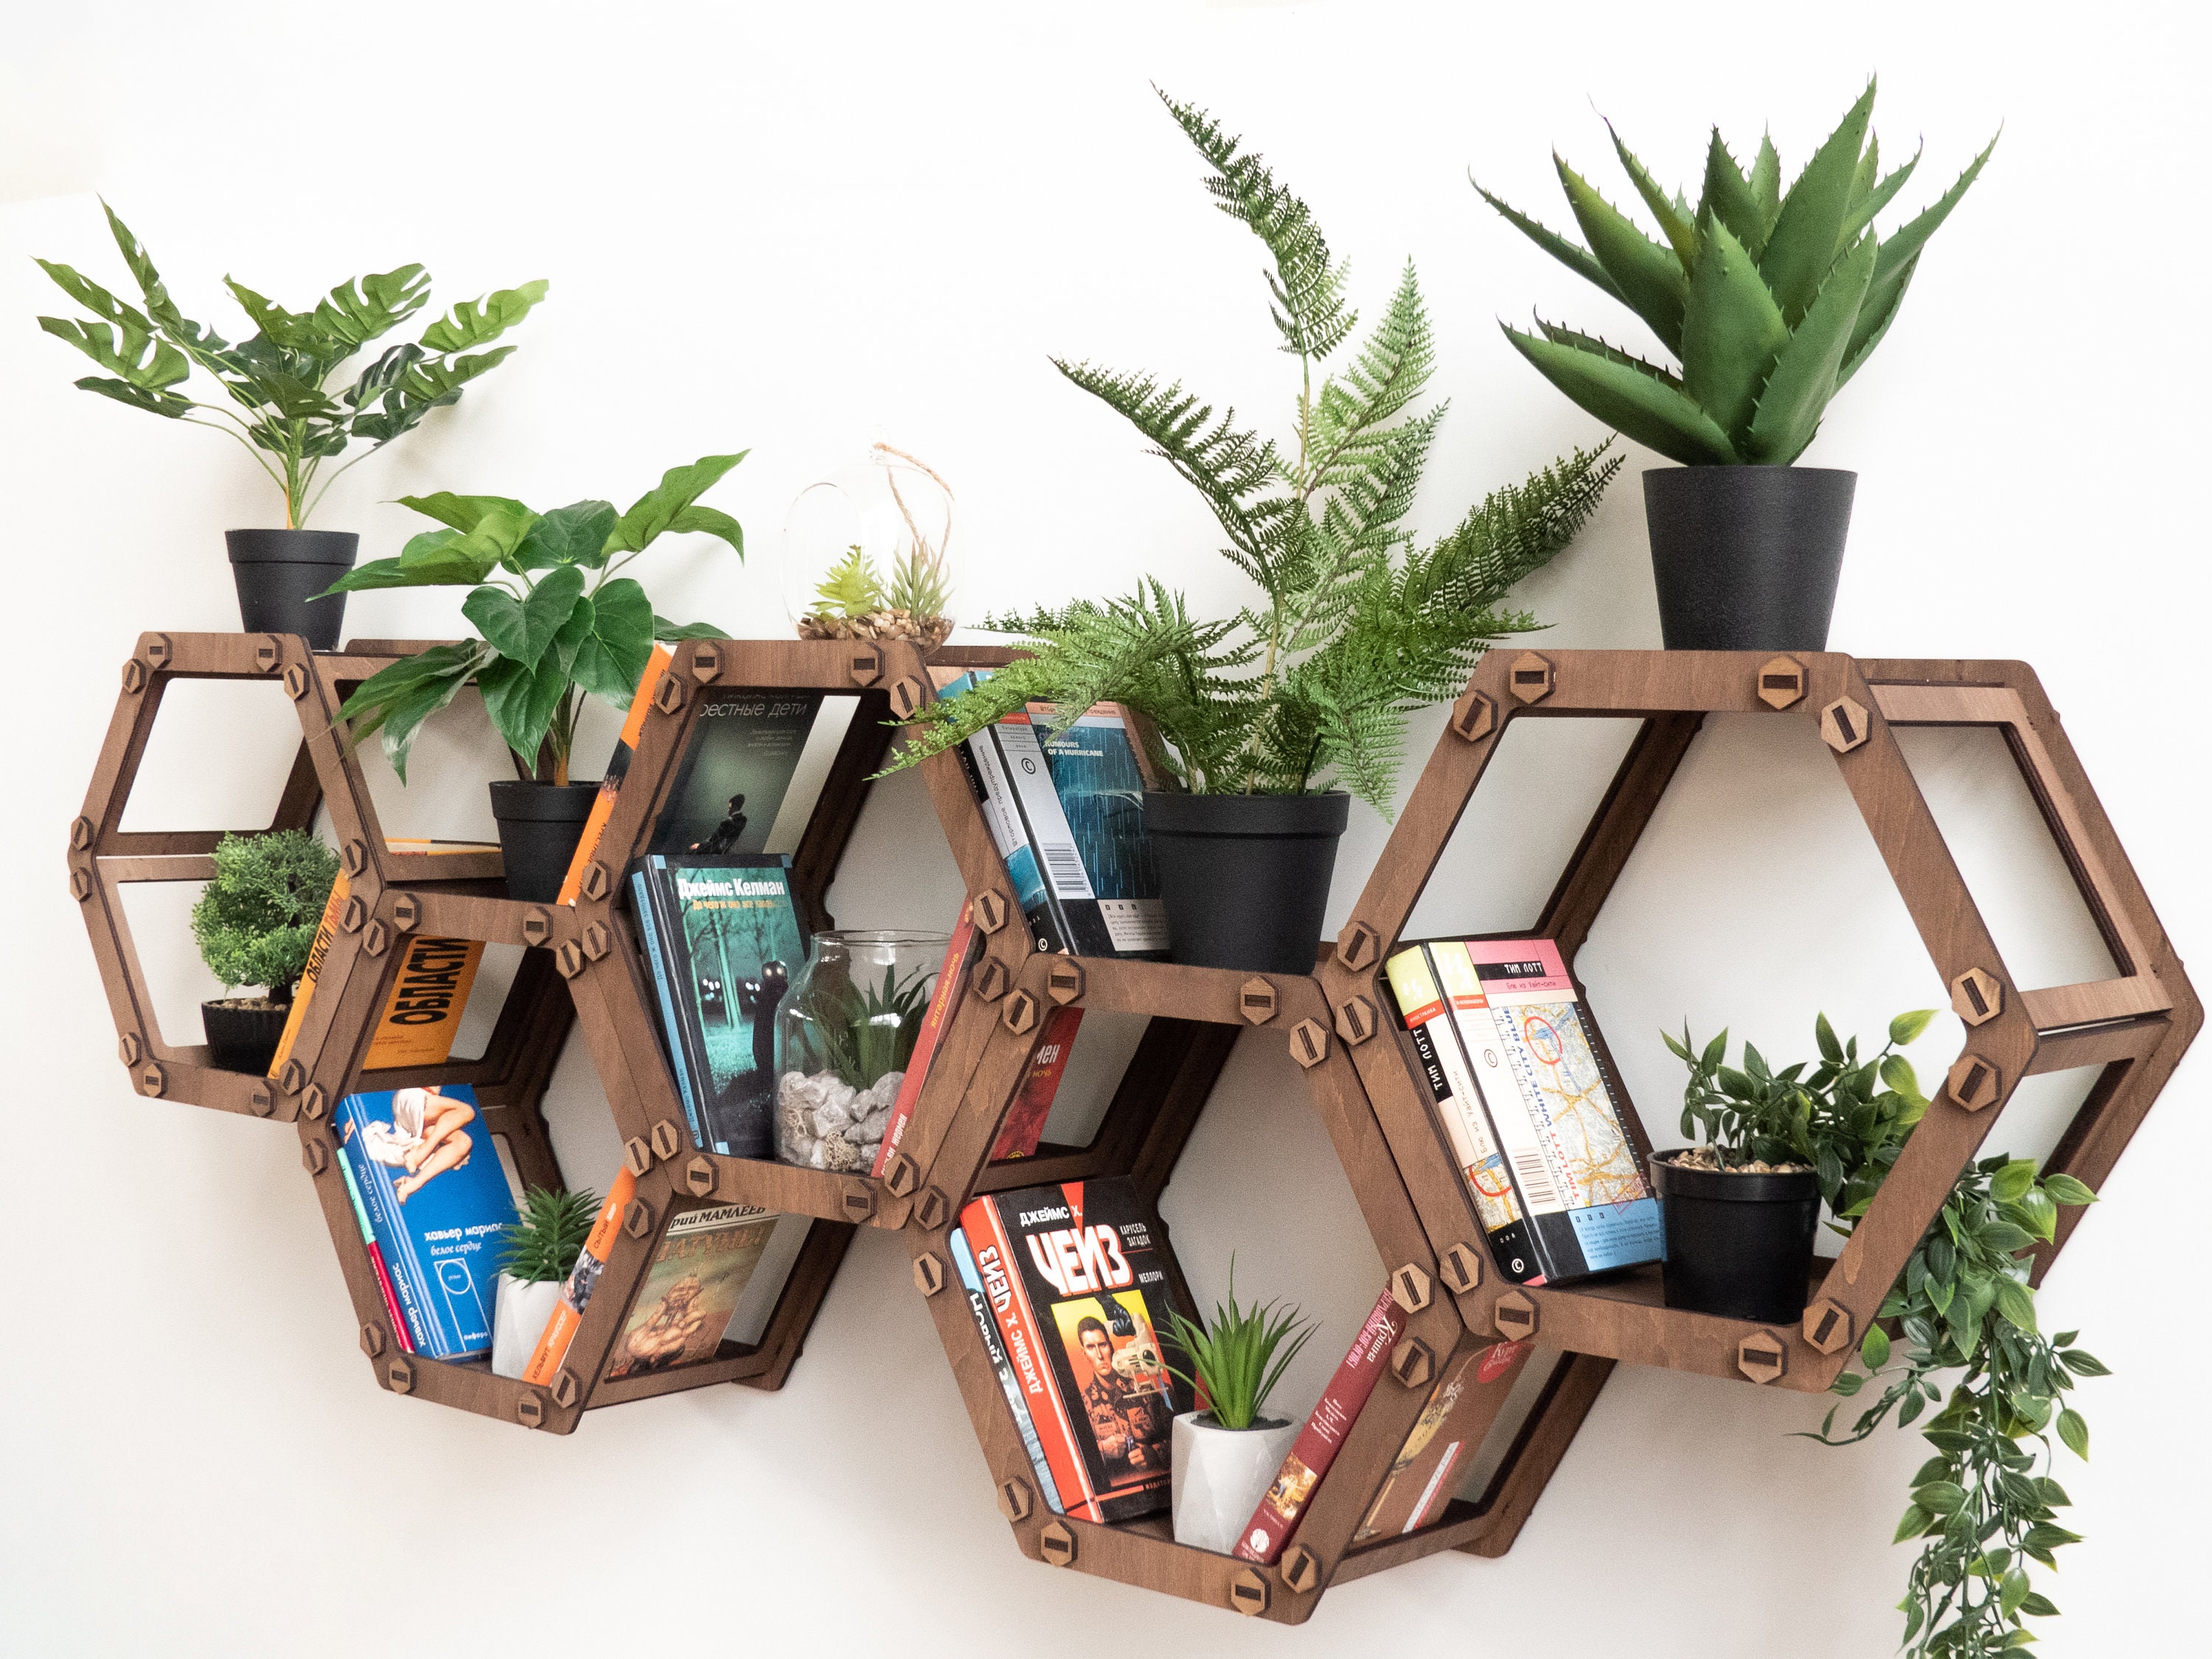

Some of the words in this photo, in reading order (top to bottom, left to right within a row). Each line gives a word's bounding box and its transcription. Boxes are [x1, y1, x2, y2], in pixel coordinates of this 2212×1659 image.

[700, 703, 765, 717] рестные
[768, 703, 807, 717] дети
[1064, 749, 1104, 757] HURRICANE
[979, 745, 1004, 804] предупреждение
[1001, 807, 1018, 846] Штормовое
[677, 878, 734, 900] Джеймс
[733, 878, 785, 896] Келман
[692, 900, 703, 911] До
[307, 925, 333, 983] ОБЛАСТИ
[1504, 963, 1521, 973] ТИМ
[1523, 962, 1543, 973] ЛОТТ
[389, 938, 472, 1026] ОБЛАСТИ
[931, 978, 951, 1029] янтарная
[947, 953, 960, 981] ночь
[1503, 1006, 1520, 1042] BLUE
[1413, 1029, 1431, 1060] ЛОТТ
[1517, 1046, 1533, 1077] CITY
[1426, 1065, 1442, 1091] ТИМ
[1530, 1080, 1552, 1127] WHITE
[891, 1113, 908, 1152] жермен
[1549, 1130, 1569, 1172] LOTT
[358, 1163, 374, 1194] сердце
[1565, 1172, 1580, 1200] TIM
[369, 1195, 383, 1223] белое
[670, 1212, 697, 1228] рий
[1019, 1206, 1070, 1227] ДЖЕЙМС
[424, 1228, 462, 1241] хавьер
[594, 1221, 610, 1249] СЫТЫЙ
[1119, 1222, 1147, 1235] КАРУСЕЛЬ
[1127, 1234, 1151, 1248] ЗАГАДОК
[431, 1244, 453, 1256] белое
[456, 1241, 481, 1254] сердце
[391, 1262, 412, 1305] мариас
[1138, 1270, 1164, 1284] МЕЛЛОРИ
[406, 1306, 427, 1347] хавьер
[532, 1347, 550, 1381] ХЕЛЬМУТ
[1011, 1329, 1043, 1394] ДЖЕЙМС
